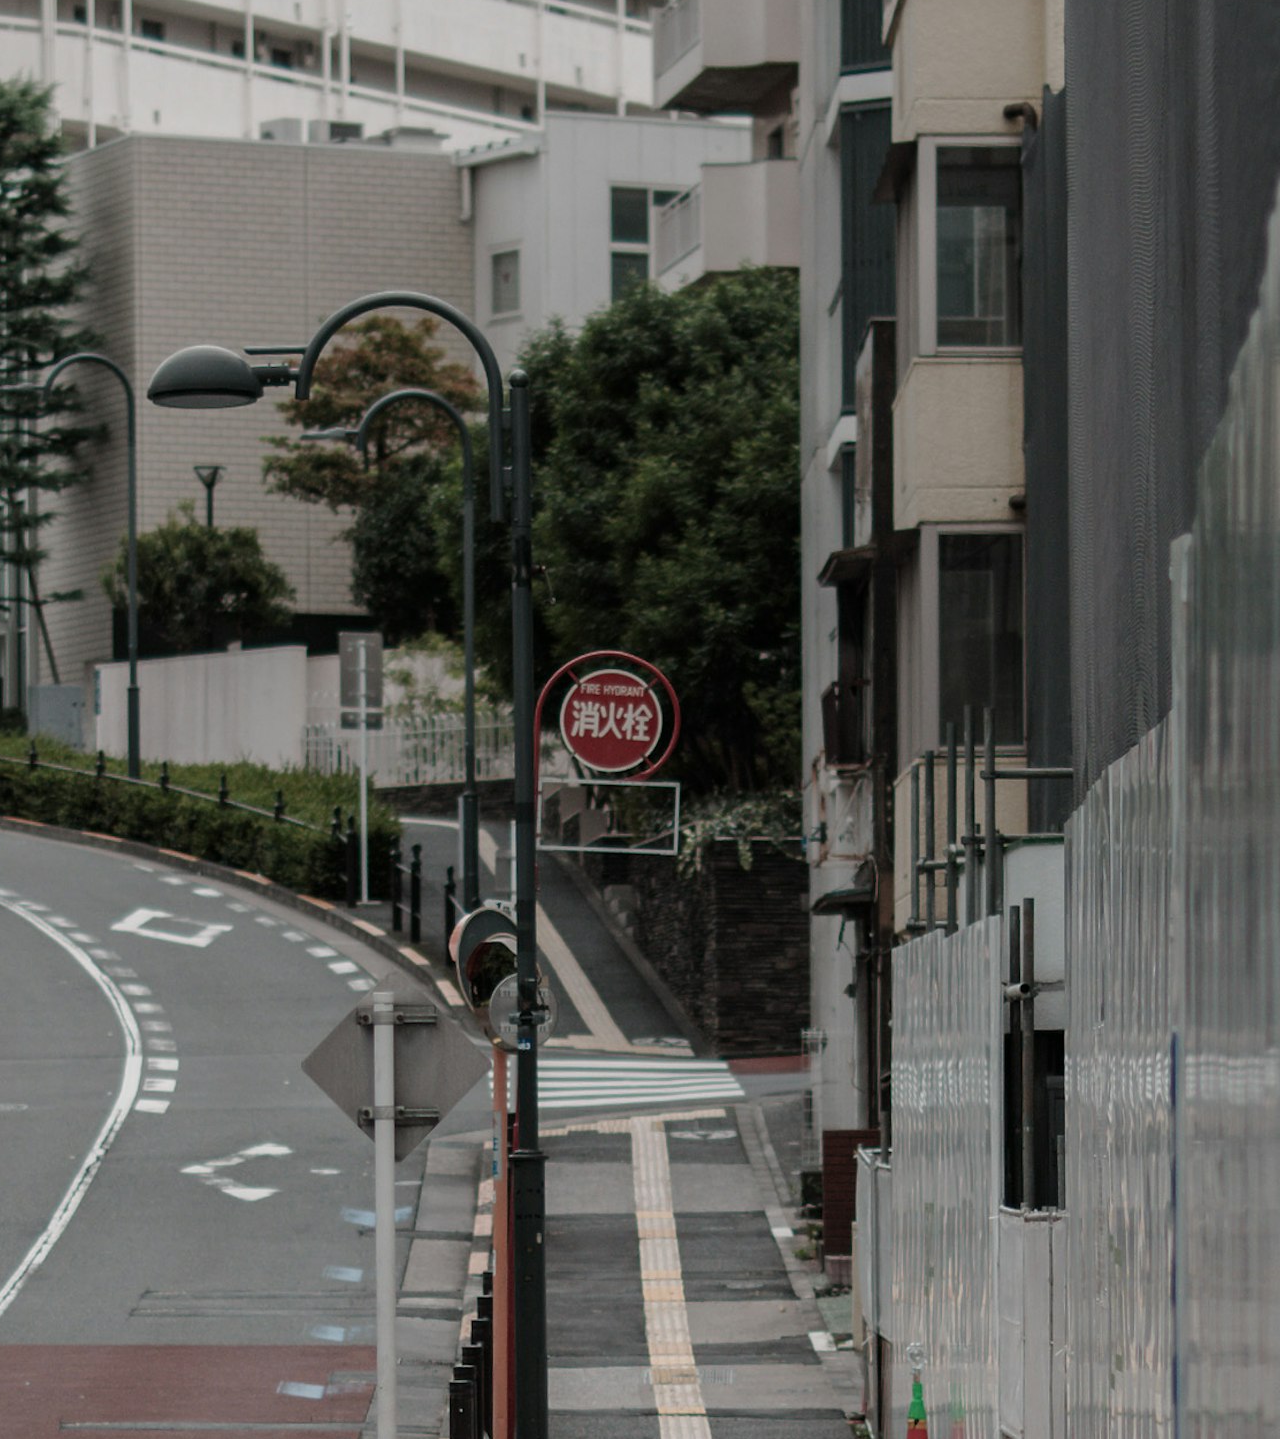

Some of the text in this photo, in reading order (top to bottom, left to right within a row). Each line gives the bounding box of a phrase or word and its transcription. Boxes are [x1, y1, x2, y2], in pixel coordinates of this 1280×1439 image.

[580, 683, 645, 698] FIRE HYDRANT
[570, 700, 654, 742] 消火栓
